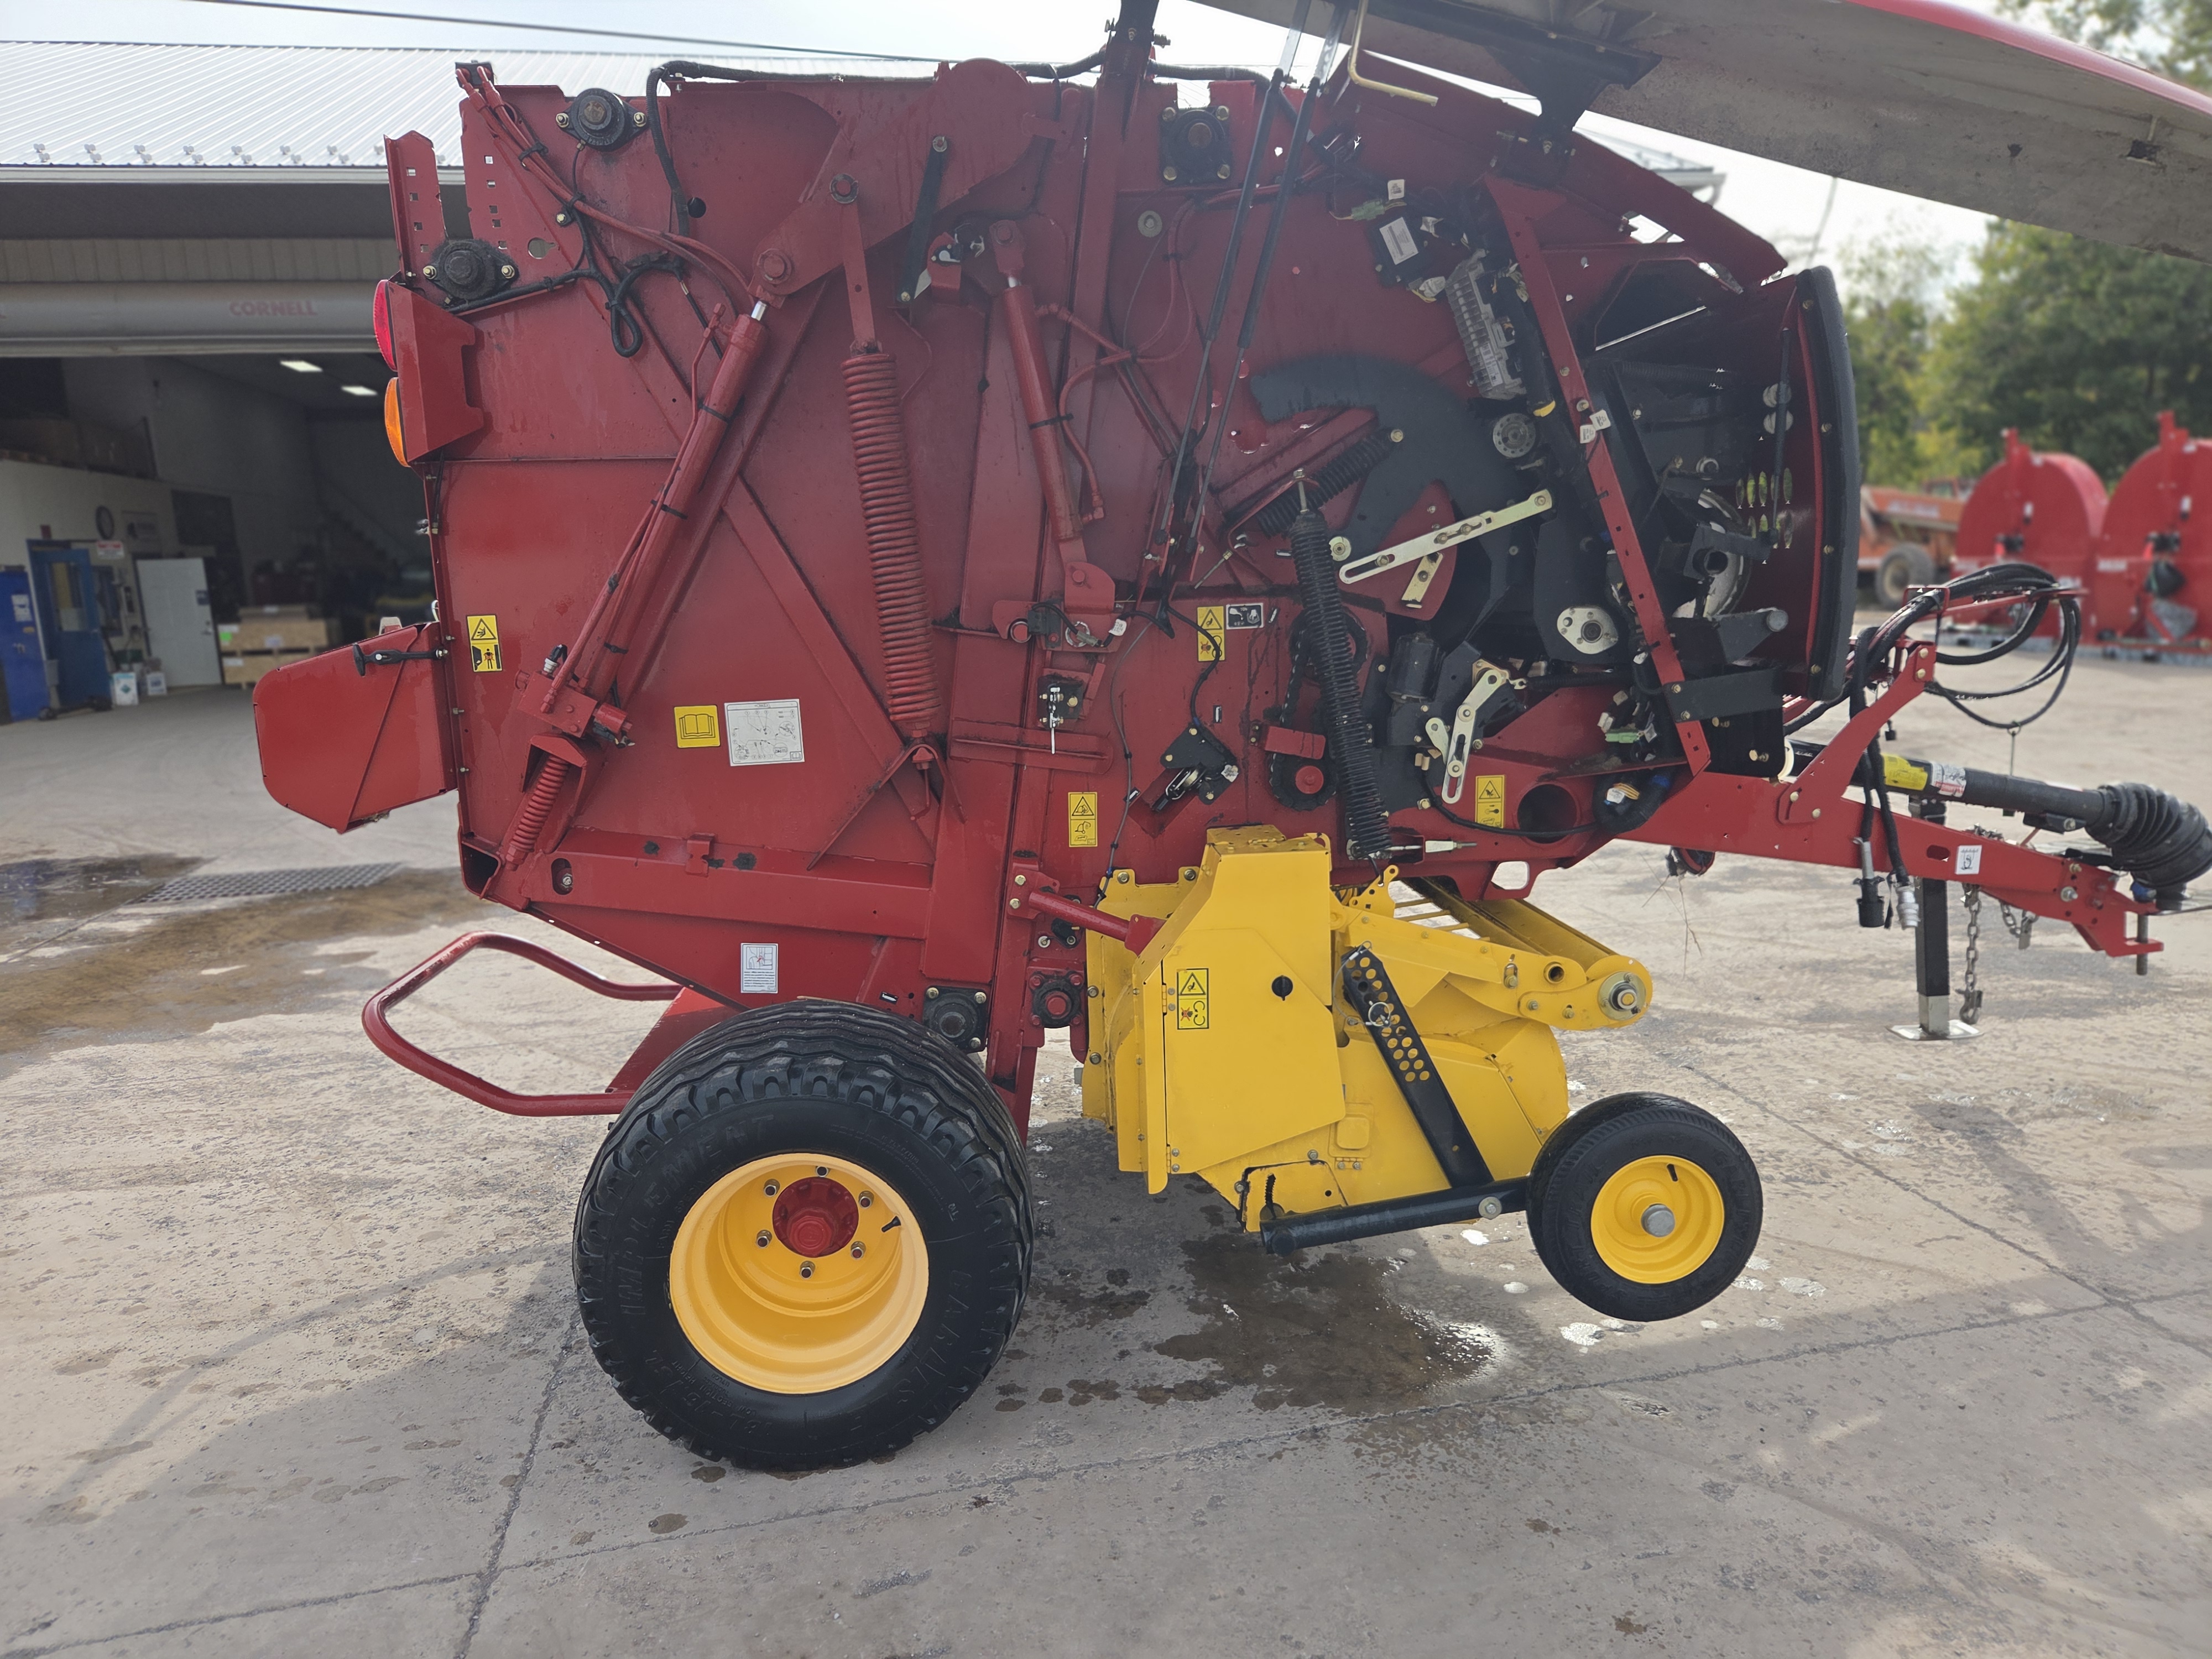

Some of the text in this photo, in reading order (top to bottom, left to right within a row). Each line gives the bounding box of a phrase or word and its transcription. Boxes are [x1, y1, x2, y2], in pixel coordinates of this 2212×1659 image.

[229, 301, 317, 316] CORNELL
[617, 1115, 775, 1316] IMPLEMENT
[671, 1360, 697, 1385] HEIGHT
[698, 1384, 734, 1408] SECTION
